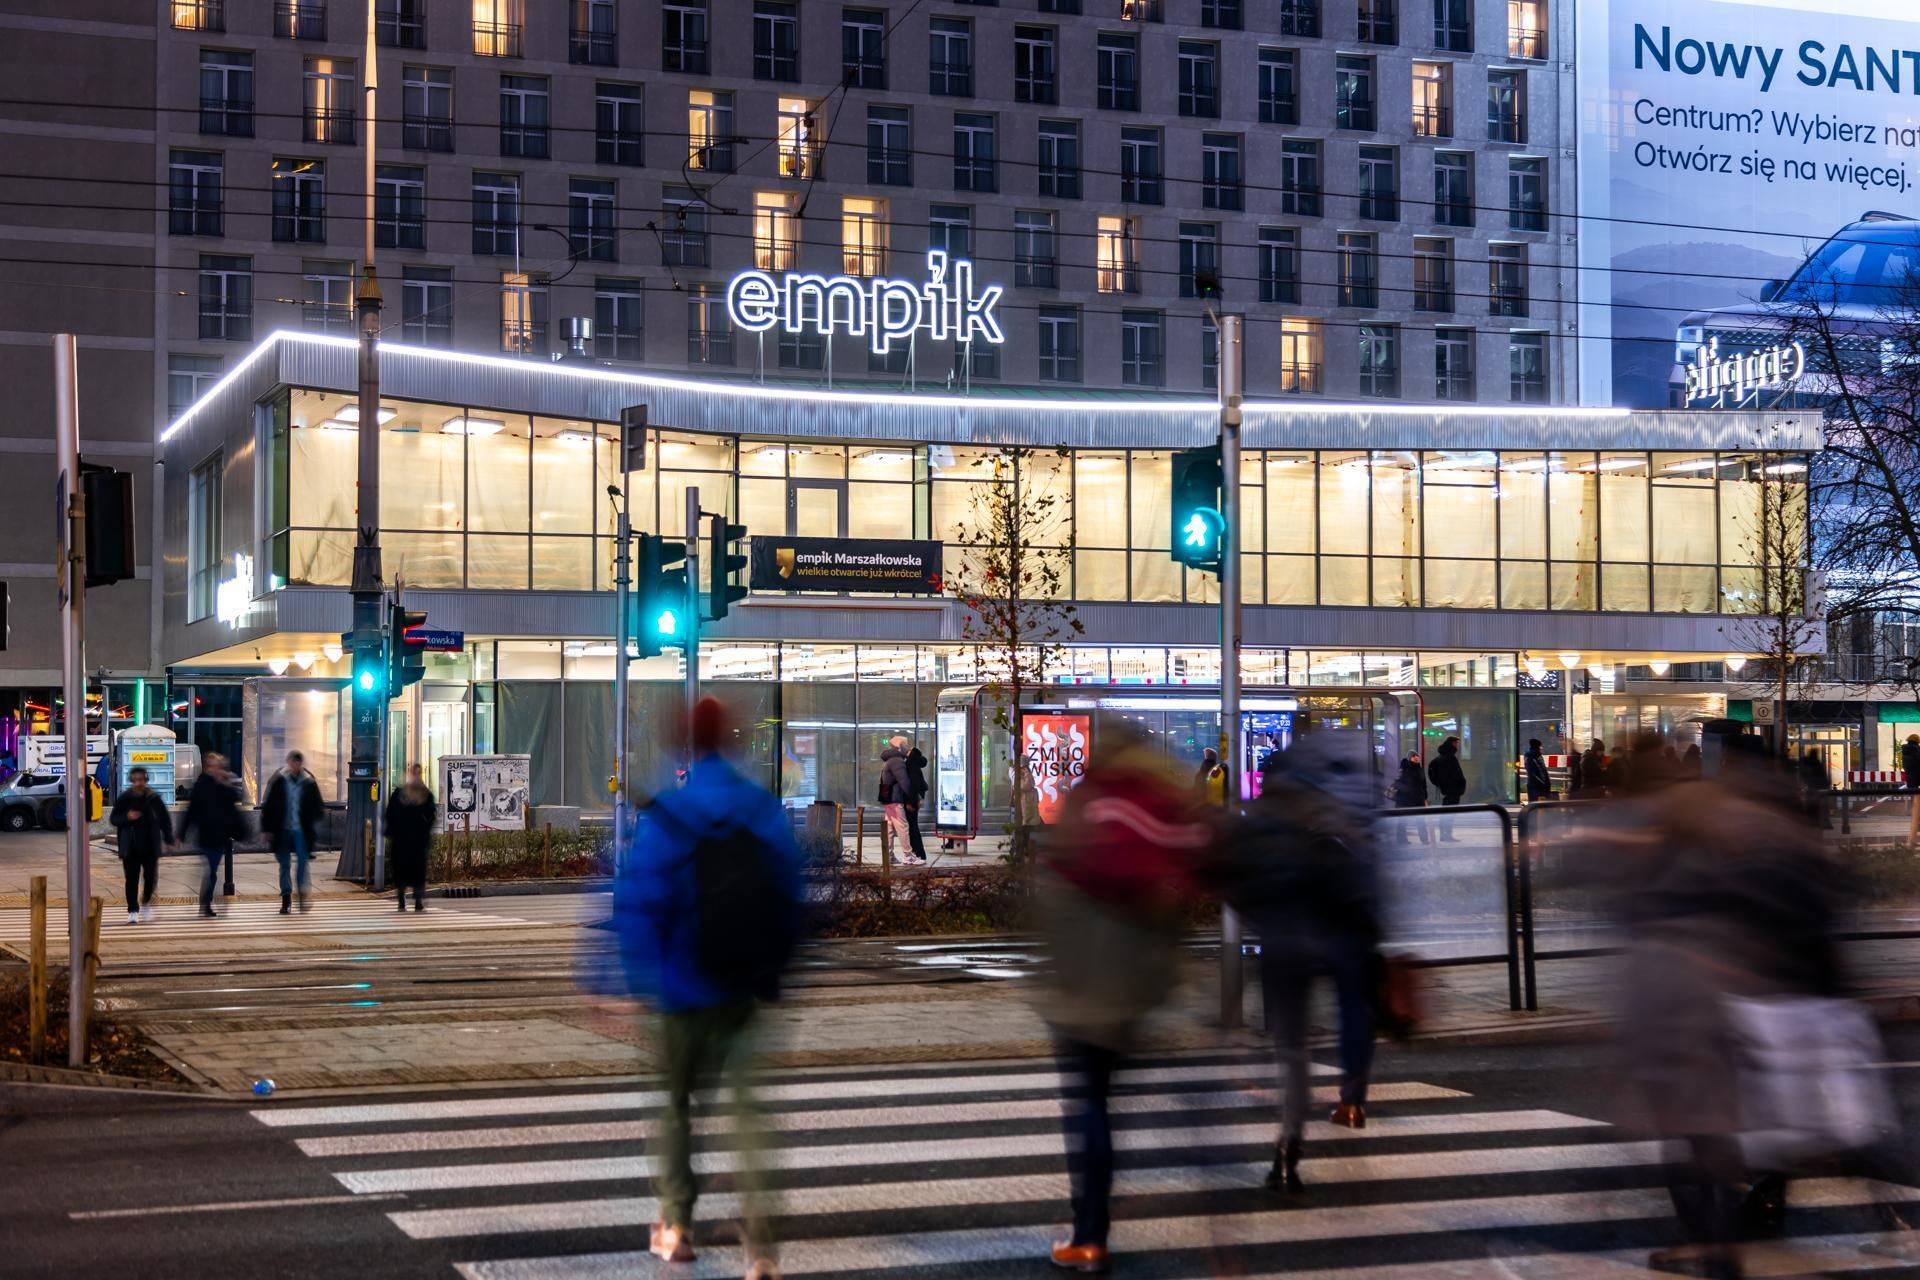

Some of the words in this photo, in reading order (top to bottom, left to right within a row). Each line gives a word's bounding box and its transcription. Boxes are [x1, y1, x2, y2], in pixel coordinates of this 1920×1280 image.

[1634, 23, 1784, 92] Nowy
[1634, 98, 1763, 134] Centrum?
[1771, 110, 1876, 145] Wybierz
[1634, 141, 1732, 174] Otwórz
[1740, 149, 1775, 183] się
[1784, 159, 1816, 180] na
[1824, 157, 1912, 194] więcej.
[796, 550, 832, 565] empik
[834, 553, 922, 566] Marszałkowska
[797, 566, 829, 576] wielkie
[830, 567, 868, 577] otwarcie
[869, 568, 883, 579] już
[884, 568, 922, 578] wkrótce!
[1028, 743, 1083, 761] ŻMIJO
[1029, 762, 1085, 776] WISKO
